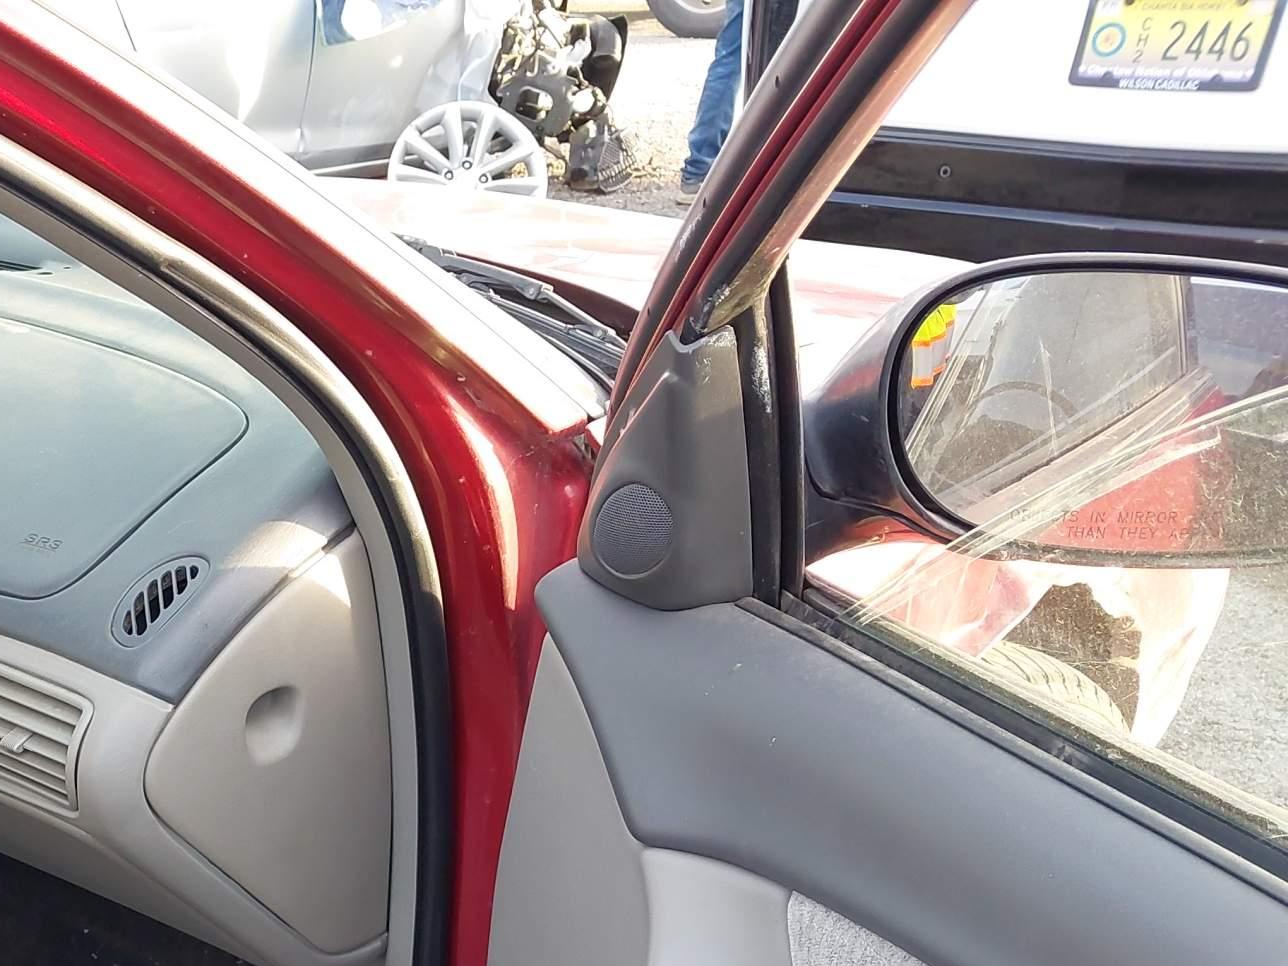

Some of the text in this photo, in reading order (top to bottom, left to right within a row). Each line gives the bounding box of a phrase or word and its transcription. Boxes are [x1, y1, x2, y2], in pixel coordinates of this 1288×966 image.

[1161, 20, 1253, 62] 2446
[1090, 511, 1107, 523] IN
[1117, 511, 1178, 523] MIRROR
[1066, 526, 1107, 539] THAN
[1119, 526, 1158, 539] THEY
[24, 533, 64, 550] SRS
